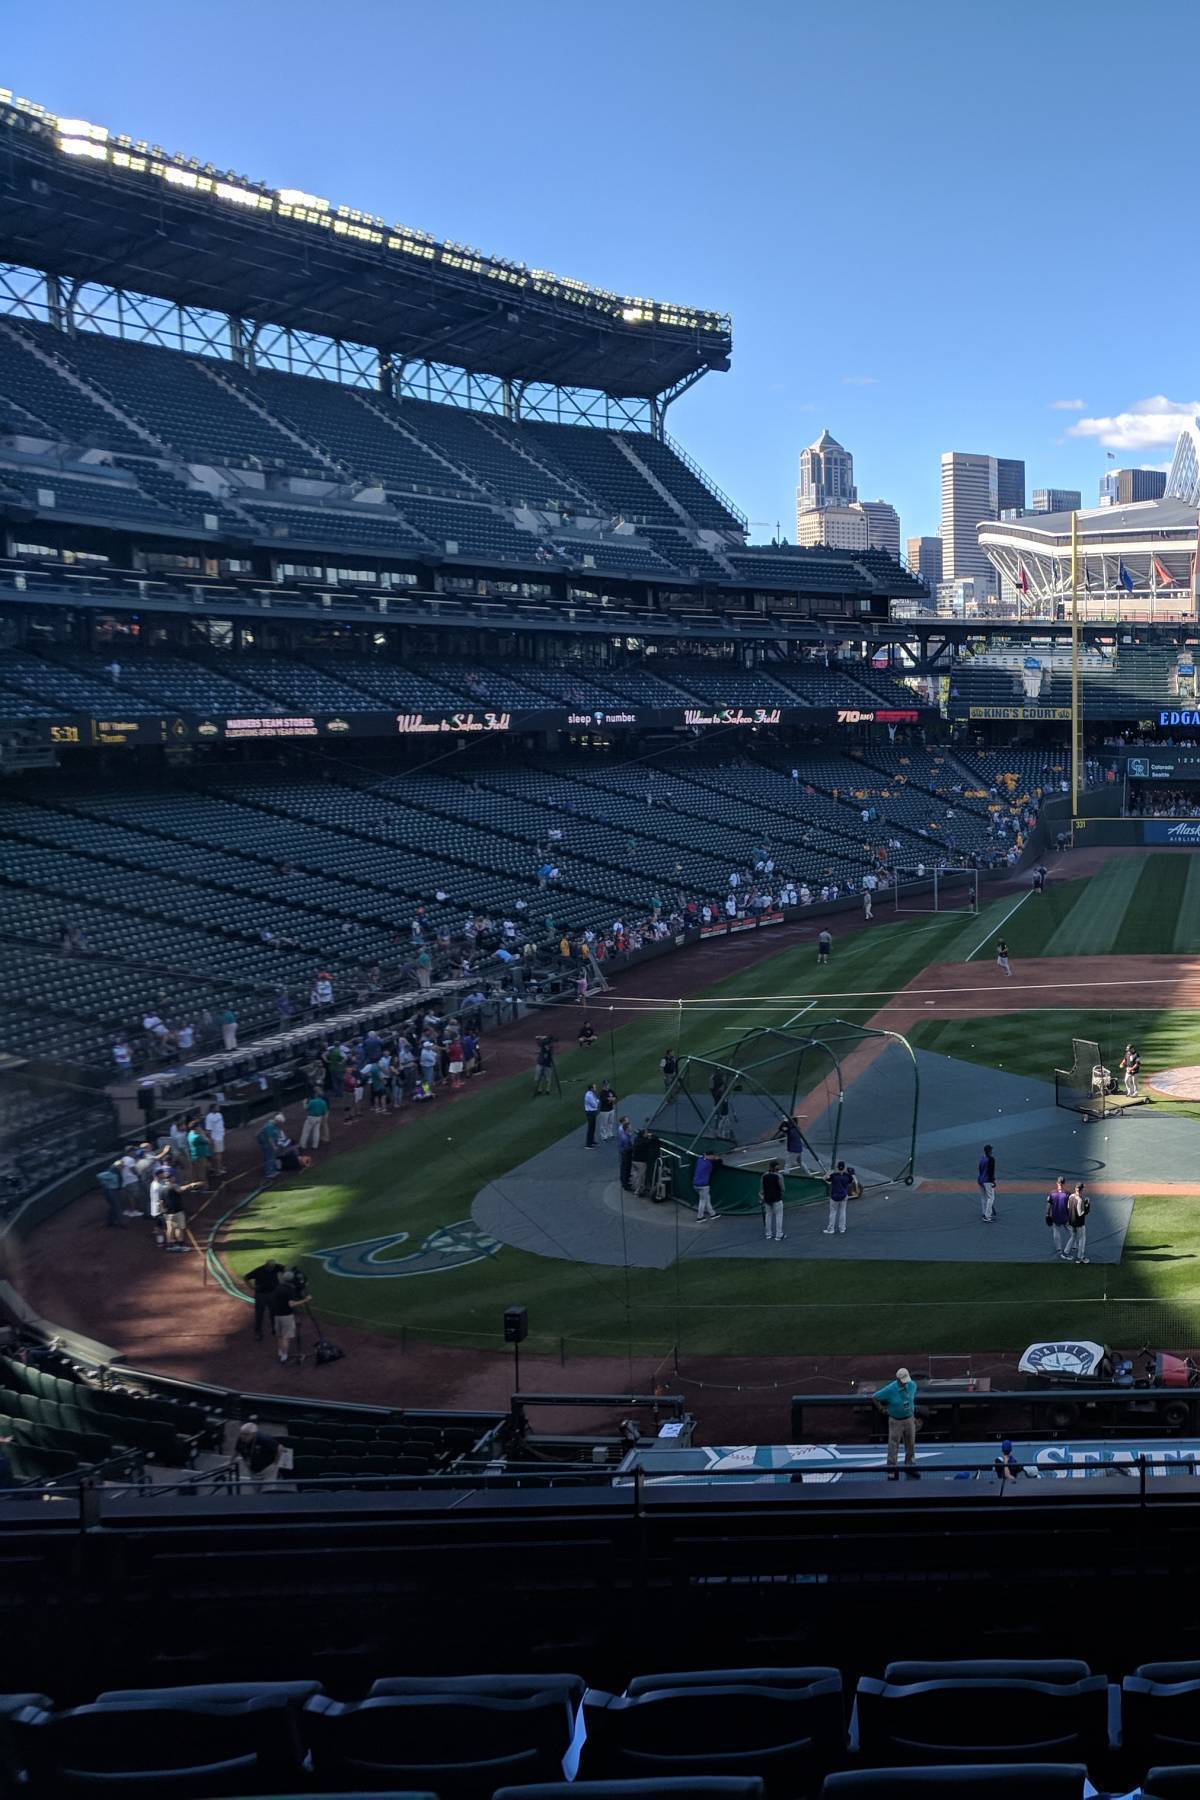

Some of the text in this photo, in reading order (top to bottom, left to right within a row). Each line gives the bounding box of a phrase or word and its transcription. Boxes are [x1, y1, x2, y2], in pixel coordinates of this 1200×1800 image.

[568, 713, 636, 725] sleep number
[684, 710, 713, 724] Welcome
[720, 710, 752, 724] Safeco
[753, 709, 781, 724] Field
[837, 710, 859, 722] 710
[984, 708, 1056, 719] KING'S COURT
[284, 718, 315, 727] STORES
[397, 713, 511, 732] Welcome to Safeco Field
[1076, 821, 1086, 829] 331
